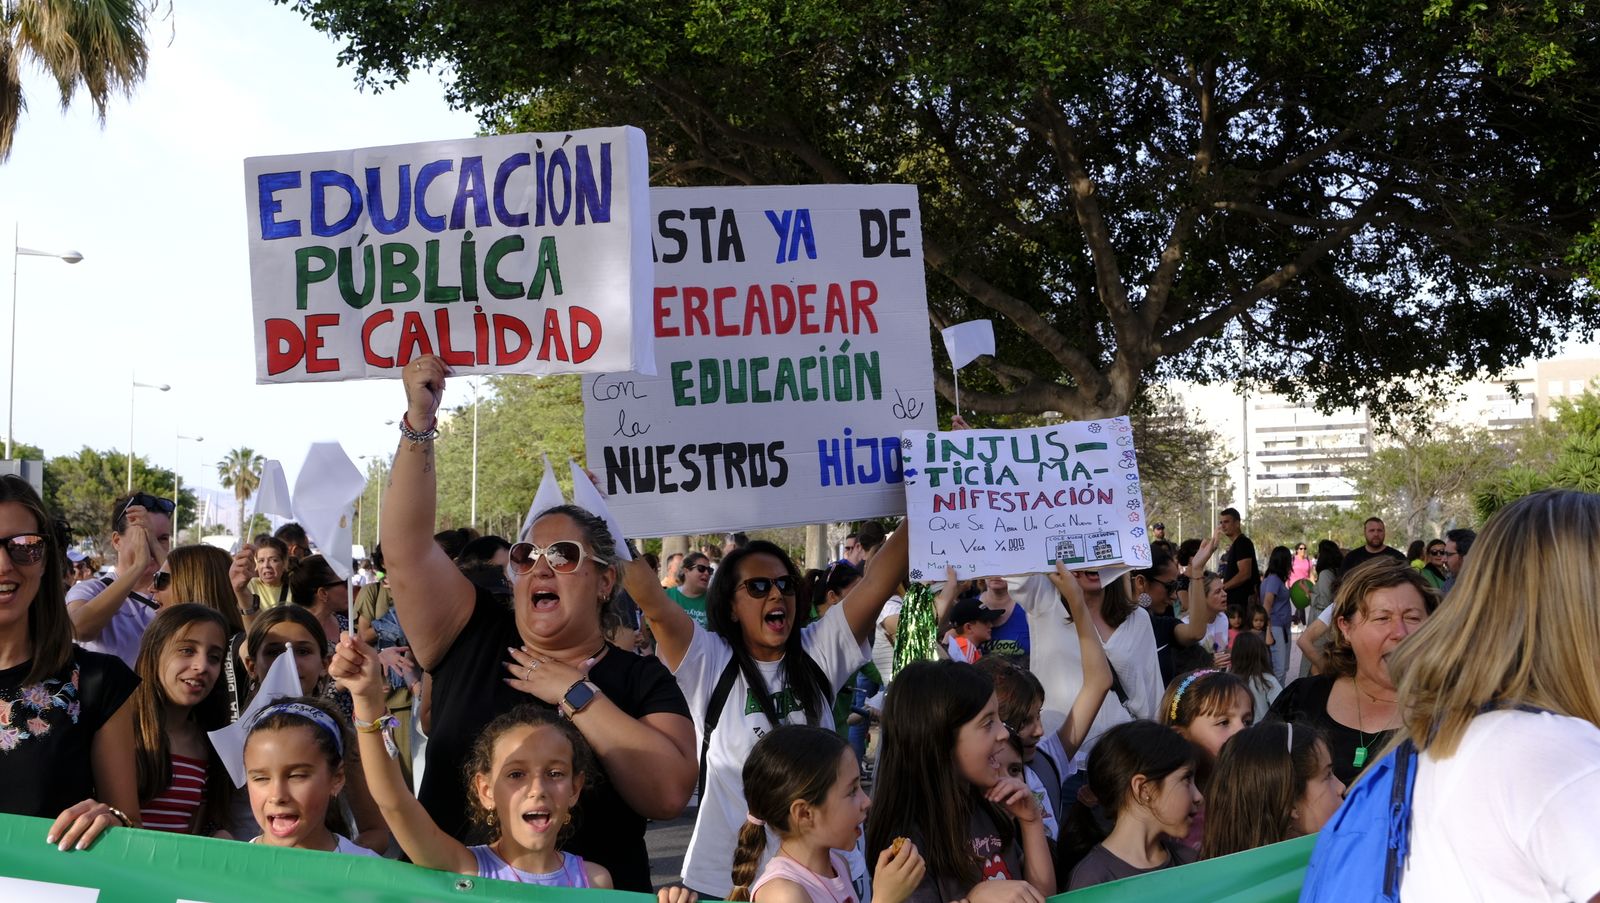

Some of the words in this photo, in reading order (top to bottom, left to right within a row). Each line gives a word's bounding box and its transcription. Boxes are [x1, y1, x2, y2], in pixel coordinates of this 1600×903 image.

[258, 135, 612, 240] EDUCACIÓN
[651, 206, 746, 264] STA
[764, 208, 818, 264] YA
[859, 208, 911, 259] DE
[295, 230, 564, 310] PÚBLICA
[265, 313, 340, 376] DE
[361, 305, 603, 368] CALIDAD
[653, 280, 879, 338] ERCADEAR
[592, 373, 648, 402] Con
[670, 339, 883, 407] EDUCACIÓN
[892, 388, 924, 420] de
[613, 409, 651, 438] la
[603, 440, 789, 496] NUESTROS
[817, 427, 902, 487] HIJO
[924, 461, 1019, 487] TICIA
[932, 483, 1113, 513] NIFESTACIÓN
